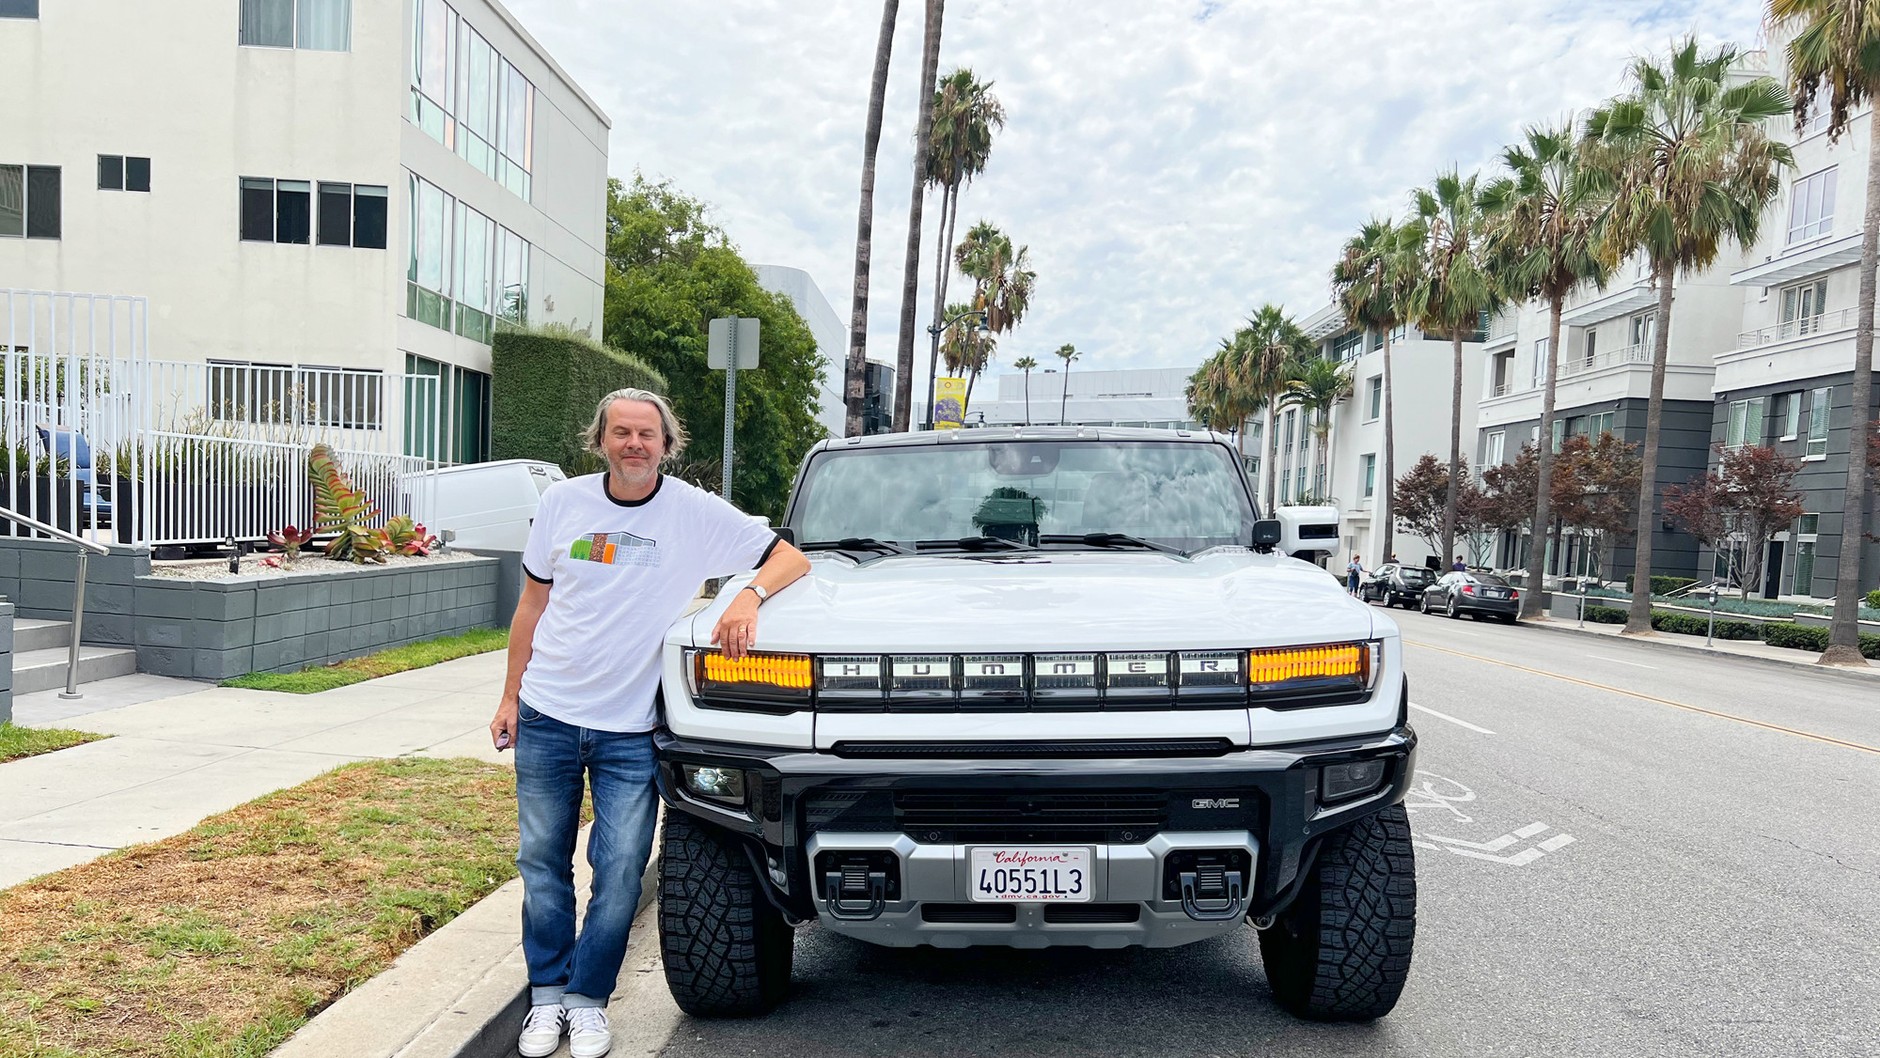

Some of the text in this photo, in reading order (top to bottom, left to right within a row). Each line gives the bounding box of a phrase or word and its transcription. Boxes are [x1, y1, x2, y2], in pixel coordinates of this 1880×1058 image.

[842, 660, 1219, 676] HUMMER
[1191, 798, 1240, 809] GMC
[995, 850, 1068, 867] California
[979, 868, 1083, 894] 40551L3
